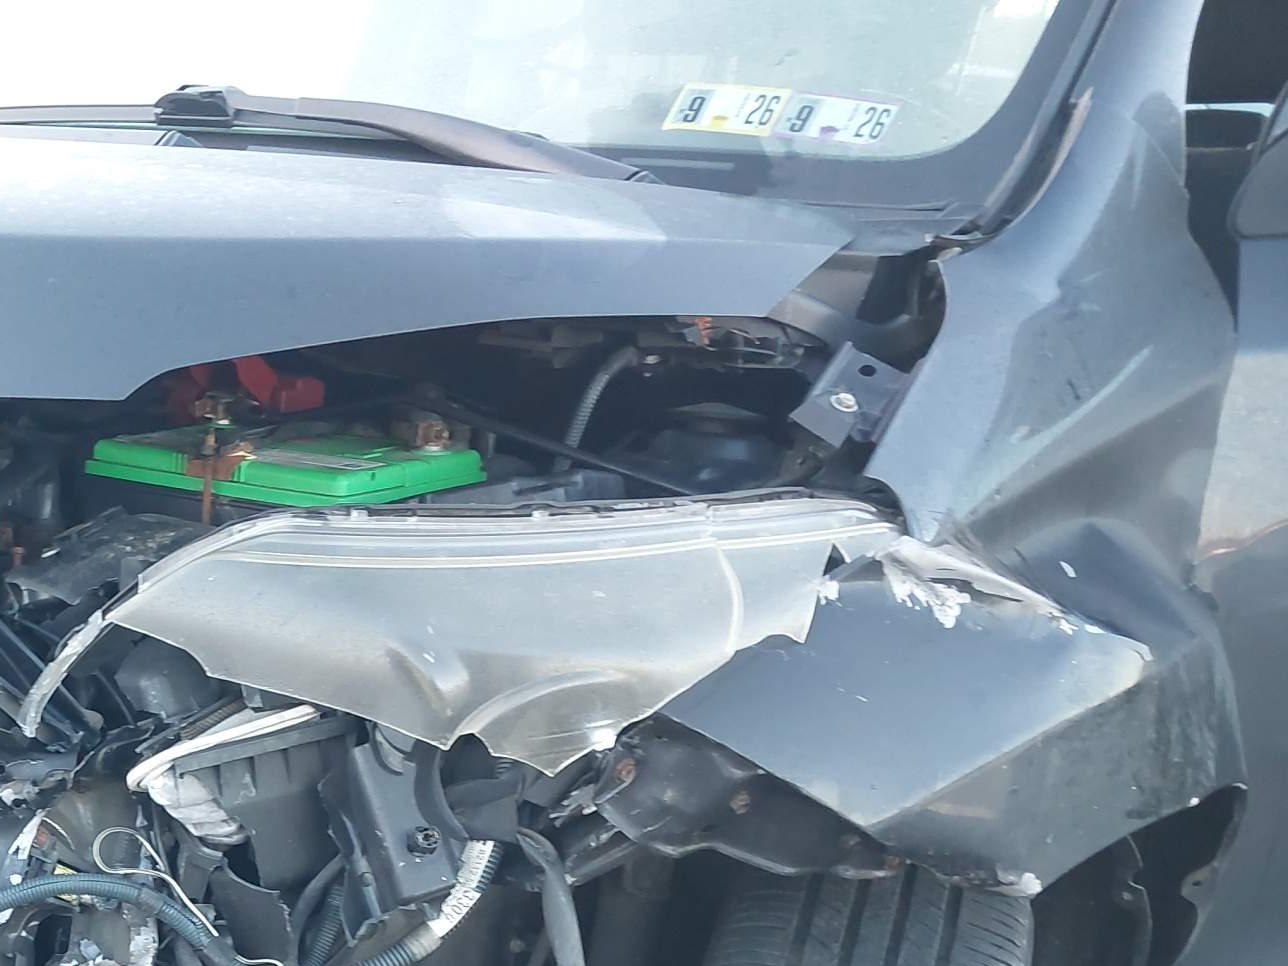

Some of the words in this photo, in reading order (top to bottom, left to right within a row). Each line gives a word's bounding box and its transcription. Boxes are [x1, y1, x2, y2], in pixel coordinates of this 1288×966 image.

[682, 96, 705, 123] 9
[744, 94, 781, 126] 26
[789, 104, 814, 133] 9
[853, 106, 891, 140] 26
